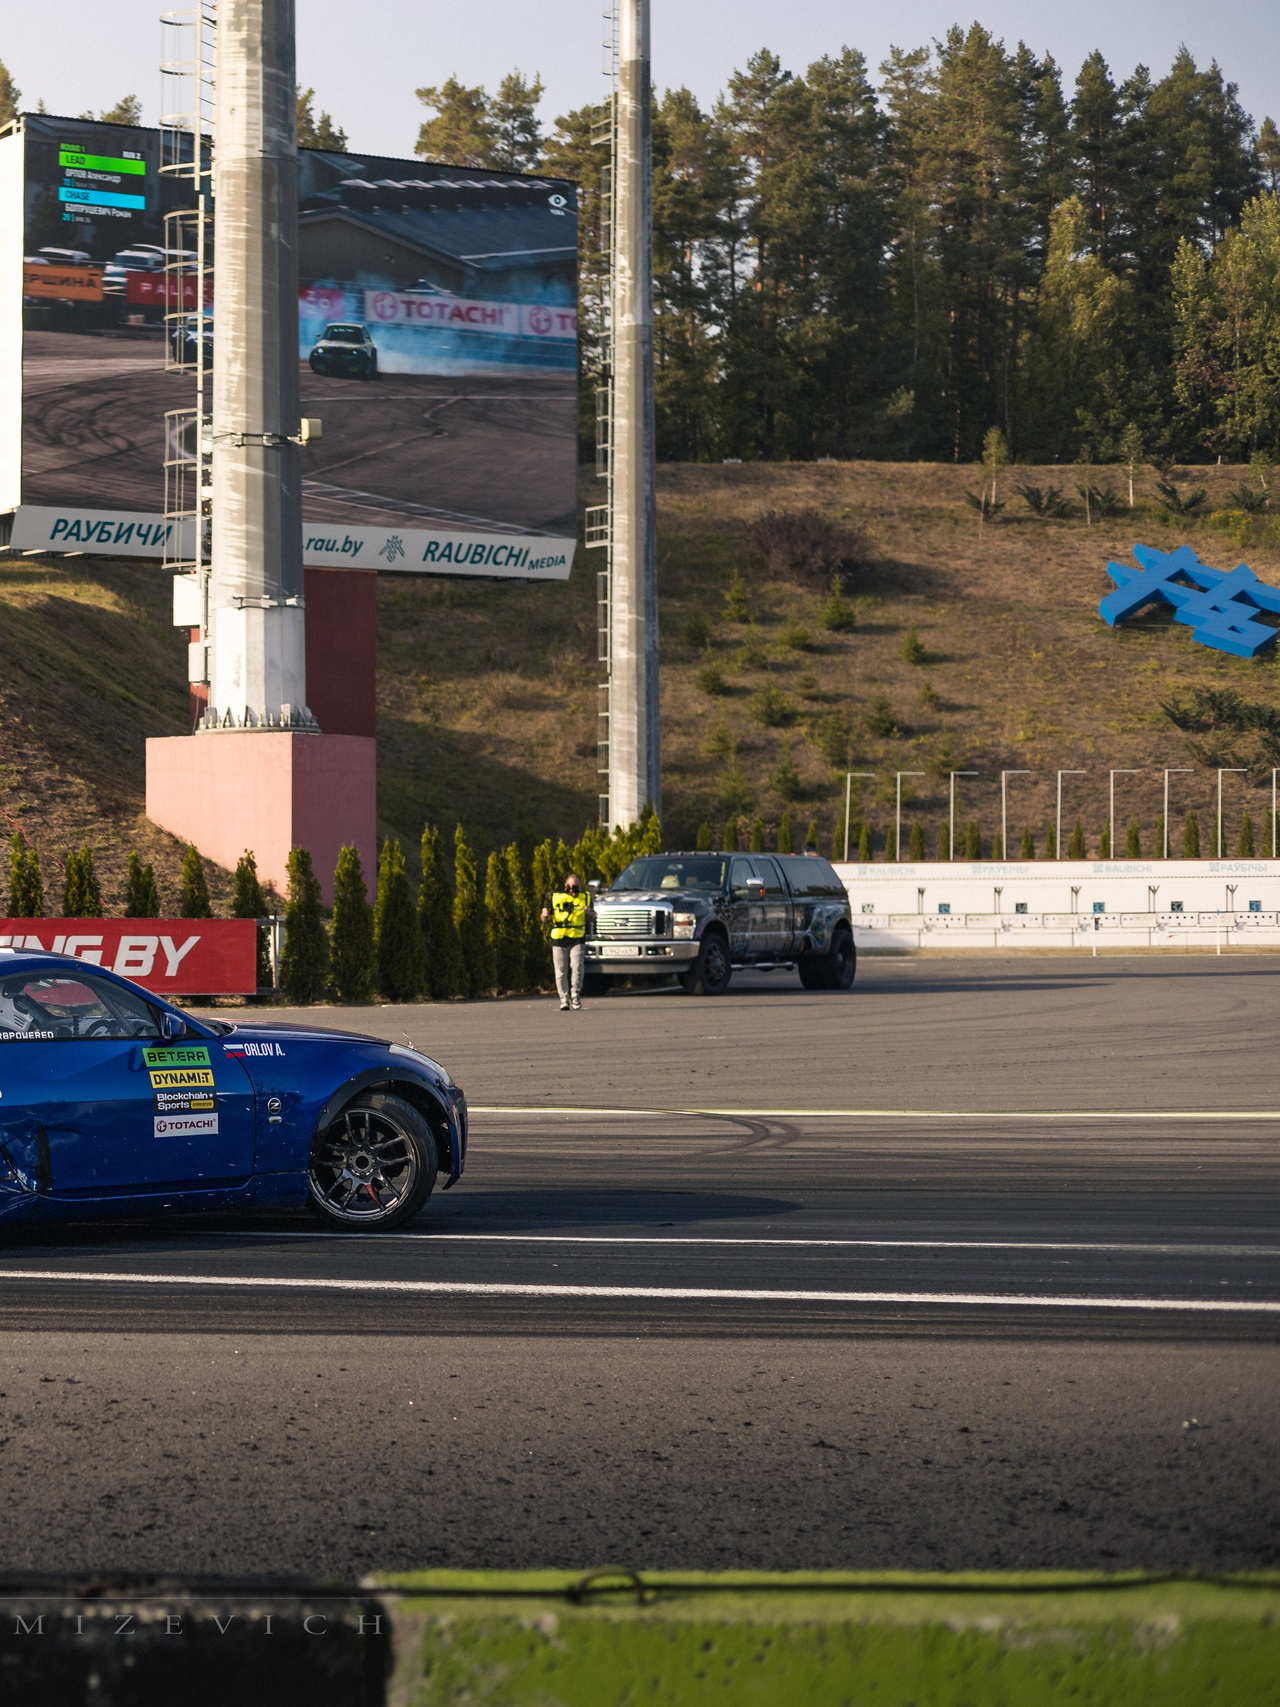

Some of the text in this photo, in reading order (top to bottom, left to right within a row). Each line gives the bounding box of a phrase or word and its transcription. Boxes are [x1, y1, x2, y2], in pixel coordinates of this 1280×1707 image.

[65, 155, 86, 165] LEAD
[65, 190, 90, 201] CHASE
[400, 300, 504, 326] TOTACHI
[49, 518, 173, 547] РАУБИЧИ
[422, 541, 566, 570] RAUBICHI MEDIA
[869, 866, 915, 875] RAUBICHI
[1105, 864, 1152, 873] RAUBICHI
[1249, 902, 1261, 911] 31
[243, 1043, 286, 1056] ORLOV A.
[156, 1091, 208, 1101] Blockchain
[157, 1101, 190, 1111] Sports
[168, 1119, 213, 1130] TOTACHI
